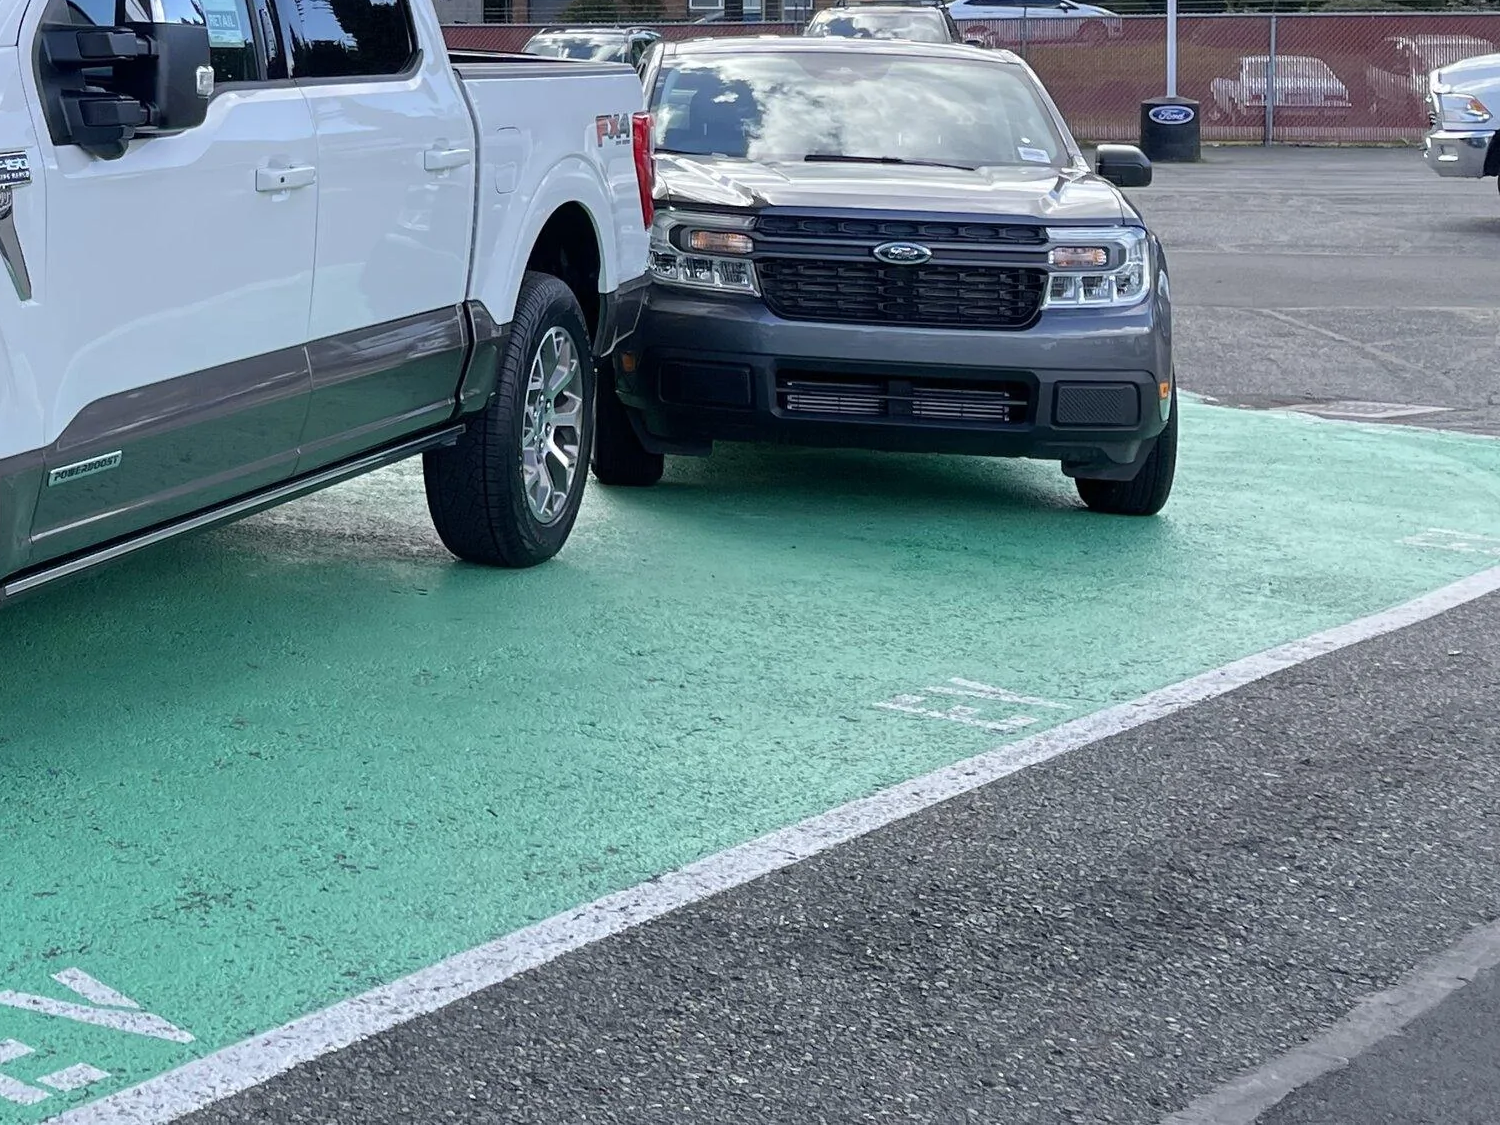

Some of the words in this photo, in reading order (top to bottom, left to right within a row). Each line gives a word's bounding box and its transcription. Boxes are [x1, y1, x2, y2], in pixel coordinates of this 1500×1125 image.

[208, 13, 236, 28] RETAIL
[596, 113, 630, 147] FX4
[53, 455, 120, 482] POWERBOOST
